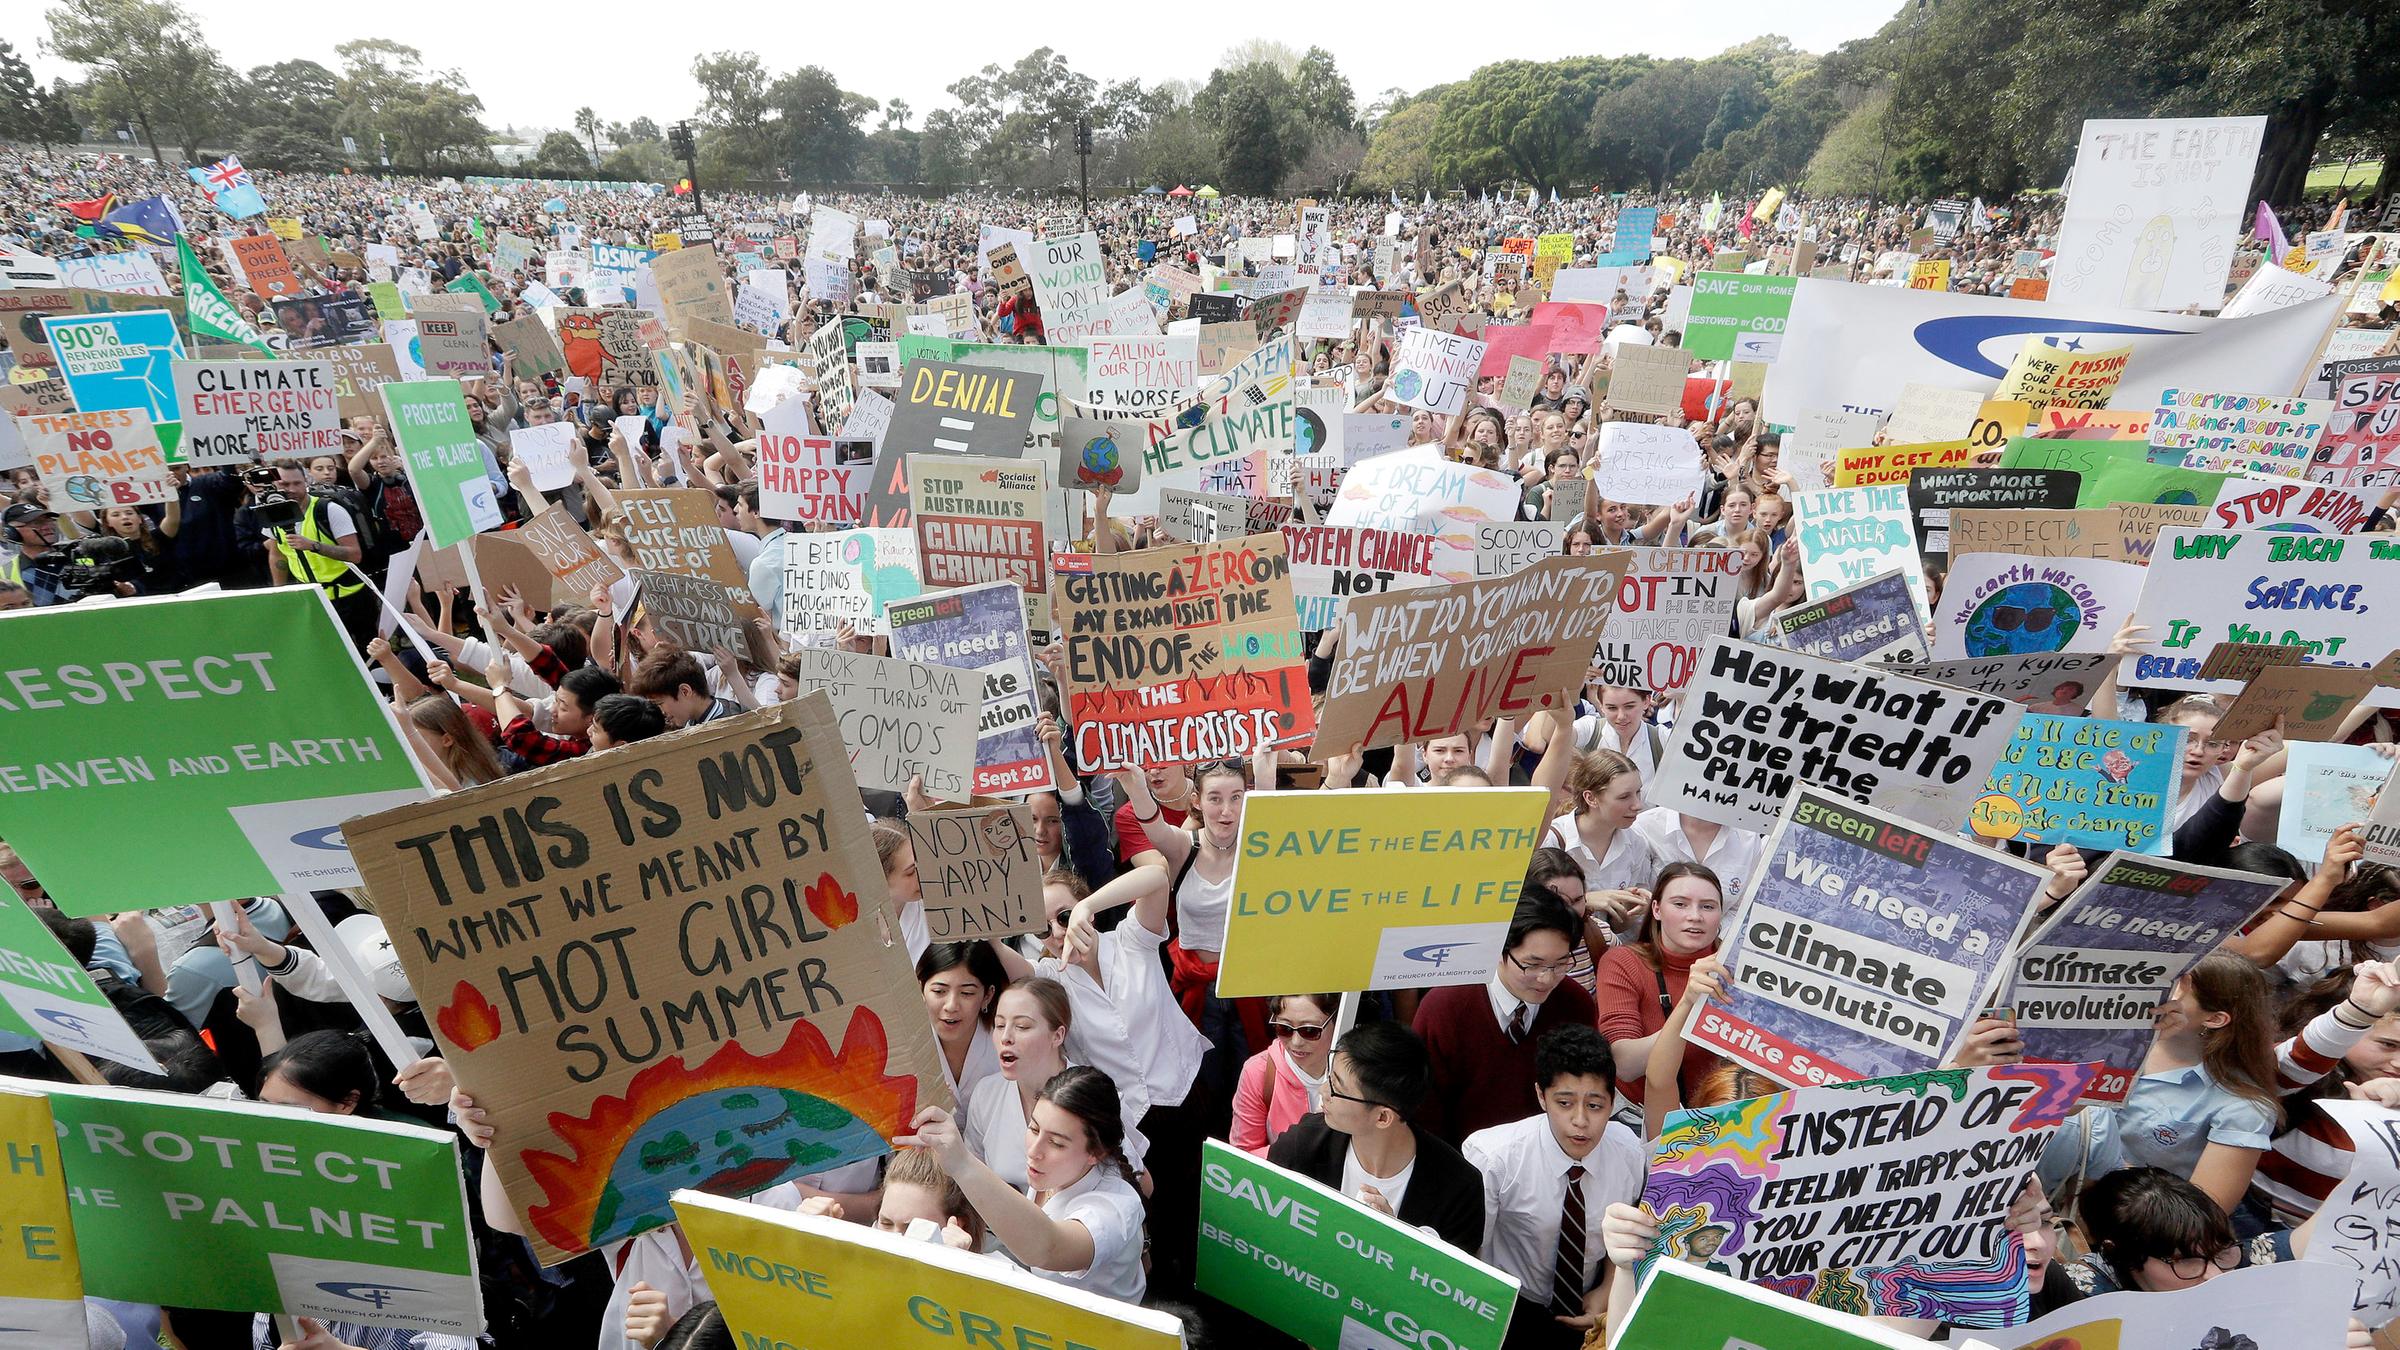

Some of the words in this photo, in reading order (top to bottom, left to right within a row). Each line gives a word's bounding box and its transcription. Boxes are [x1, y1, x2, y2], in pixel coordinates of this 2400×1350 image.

[2096, 133, 2159, 160] THE
[2170, 127, 2259, 158] EARTH
[1305, 212, 1324, 222] WAKE
[1307, 224, 1318, 233] UP
[239, 240, 274, 254] SAVE
[592, 245, 648, 267] LOSING
[1048, 245, 1084, 264] OUR
[1505, 239, 1534, 250] PLANET
[249, 254, 278, 266] OUR
[1298, 264, 1319, 275] BURN
[1303, 253, 1315, 264] OR
[1486, 254, 1525, 263] SYSTEM
[250, 266, 290, 281] TREES!
[1039, 263, 1101, 289] WORLD
[1045, 285, 1101, 310] WON'T
[1696, 279, 1739, 295] SAVE
[1742, 284, 1763, 294] OUR
[1766, 285, 1794, 295] HOME
[188, 282, 258, 344] GREENS
[1060, 308, 1090, 322] LAST
[1689, 315, 1738, 327] BESTOWED
[1740, 319, 1750, 327] BY
[1751, 316, 1785, 332] GOD
[56, 326, 119, 350] 90%
[427, 322, 455, 334] KEEP
[1047, 319, 1112, 344] FOREVER
[67, 346, 146, 362] RENEWABLES
[1093, 342, 1165, 362] FAILING
[1410, 330, 1460, 355] TIME
[1470, 343, 1484, 359] IS
[72, 363, 87, 373] BY
[91, 360, 119, 371] 2030
[198, 367, 322, 391] CLIMATE
[1099, 365, 1130, 377] OUR
[1135, 360, 1197, 388] PLANET
[2336, 363, 2379, 377] ROSES
[193, 389, 334, 415] EMERGENCY
[910, 367, 1017, 418] DENIAL
[1089, 390, 1104, 404] IS
[1115, 390, 1179, 406] WORSE
[32, 410, 132, 434] THERE'S
[246, 412, 311, 432] MEANS
[401, 402, 458, 425] PROTECT
[67, 431, 113, 451] NO
[193, 434, 249, 458] MORE
[257, 429, 341, 454] BUSHFIRES
[1187, 401, 1292, 461] CLIMATE
[38, 447, 164, 476] PLANET
[412, 450, 433, 470] THE
[438, 442, 479, 466] PLANET
[760, 434, 832, 465] NOT
[1844, 456, 1884, 471] WHY
[1891, 452, 1933, 466] GET
[1939, 449, 1967, 463] AN
[764, 465, 852, 493] HAPPY
[923, 478, 963, 494] STOP
[999, 471, 1036, 482] Socialist
[1000, 479, 1035, 491] Alliance
[1920, 474, 1979, 489] WHAT'S
[1991, 474, 2047, 487] MORE
[924, 496, 1024, 516] AUSTRALIA'S
[1801, 492, 1854, 518] LIKE
[1862, 485, 1905, 511] THE
[1934, 489, 2048, 504] IMPORTANT?
[622, 499, 678, 525] FELT
[524, 511, 576, 557] SAVE
[627, 528, 675, 547] CUTE
[673, 525, 723, 546] MIGHT
[924, 521, 1033, 556] CLIMATE
[1481, 528, 1553, 549] SCOMO
[1818, 524, 1885, 548] WATER
[1961, 520, 2065, 541] RESPECT
[553, 542, 583, 569] OUR
[638, 552, 679, 570] DIE
[684, 550, 712, 568] OF
[788, 542, 798, 566] I
[809, 540, 841, 565] BET
[1280, 527, 1352, 564] SYSTEM
[1359, 529, 1436, 575] CHANGE
[2174, 535, 2241, 559] WHY
[2267, 537, 2345, 562] TEACH
[562, 558, 611, 594] FUTURE
[785, 570, 814, 589] THE
[820, 571, 849, 590] DINOS
[929, 554, 1037, 586] CRIMES!
[1840, 558, 1876, 578] WE
[1332, 569, 1394, 594] NOT
[1672, 577, 1716, 597] IN
[785, 594, 837, 612] THOUGHT
[838, 596, 868, 612] THEY
[1346, 599, 1433, 657] WHAT
[1437, 597, 1467, 634] DO
[1470, 585, 1520, 627] YOU
[1514, 567, 1578, 607] WANT
[1582, 567, 1614, 597] TO
[1666, 600, 1730, 614] HERE
[1070, 634, 1145, 682] END
[1150, 634, 1191, 677] OF
[1331, 659, 1370, 698] BE
[1374, 642, 1448, 687] WHEN
[1461, 626, 1507, 669] YOU
[1499, 611, 1566, 656] GROW
[1562, 605, 1610, 641] UP?
[1363, 647, 1556, 747] ALIVE.
[1711, 646, 1804, 704] Hey,
[1811, 672, 1945, 720] what
[1950, 699, 2005, 737] if
[1702, 692, 1771, 732] we
[1778, 704, 1924, 776] tried
[1923, 735, 1971, 783] to
[168, 755, 229, 778] AND
[232, 737, 382, 771] EARTH
[396, 797, 589, 906] THIS
[603, 770, 681, 846] IS
[697, 730, 806, 820] NOT
[910, 815, 988, 858] NOT
[1246, 828, 1360, 858] SAVE
[1370, 837, 1415, 852] THE
[1419, 827, 1536, 852] EARTH
[1796, 801, 1877, 842] green
[1878, 824, 1930, 863] left
[417, 894, 542, 962] WHAT
[560, 873, 626, 922] WE
[639, 828, 760, 899] MEANT
[782, 809, 832, 859] BY
[919, 857, 1011, 898] HAPPY
[1238, 888, 1351, 916] LOVE
[1362, 890, 1408, 906] THE
[1422, 880, 1522, 907] LIFE
[925, 895, 1027, 936] JAN!
[497, 927, 641, 1033] HOT
[679, 879, 828, 977] GIRL
[1748, 921, 1947, 1006] climate
[1740, 960, 1941, 1046] revolution
[557, 959, 844, 1083] SUMMER
[1772, 1095, 1948, 1160] INSTEAD
[1960, 1086, 2036, 1129] OF
[165, 1192, 445, 1249] PALNET
[1204, 1163, 1320, 1238] SAVE
[1336, 1231, 1394, 1271] OUR
[1409, 1267, 1499, 1321] HOME
[1738, 1243, 1821, 1281] YOUR
[1829, 1225, 1920, 1270] CITY
[1920, 1216, 2008, 1259] OUT
[708, 1248, 832, 1299] MORE
